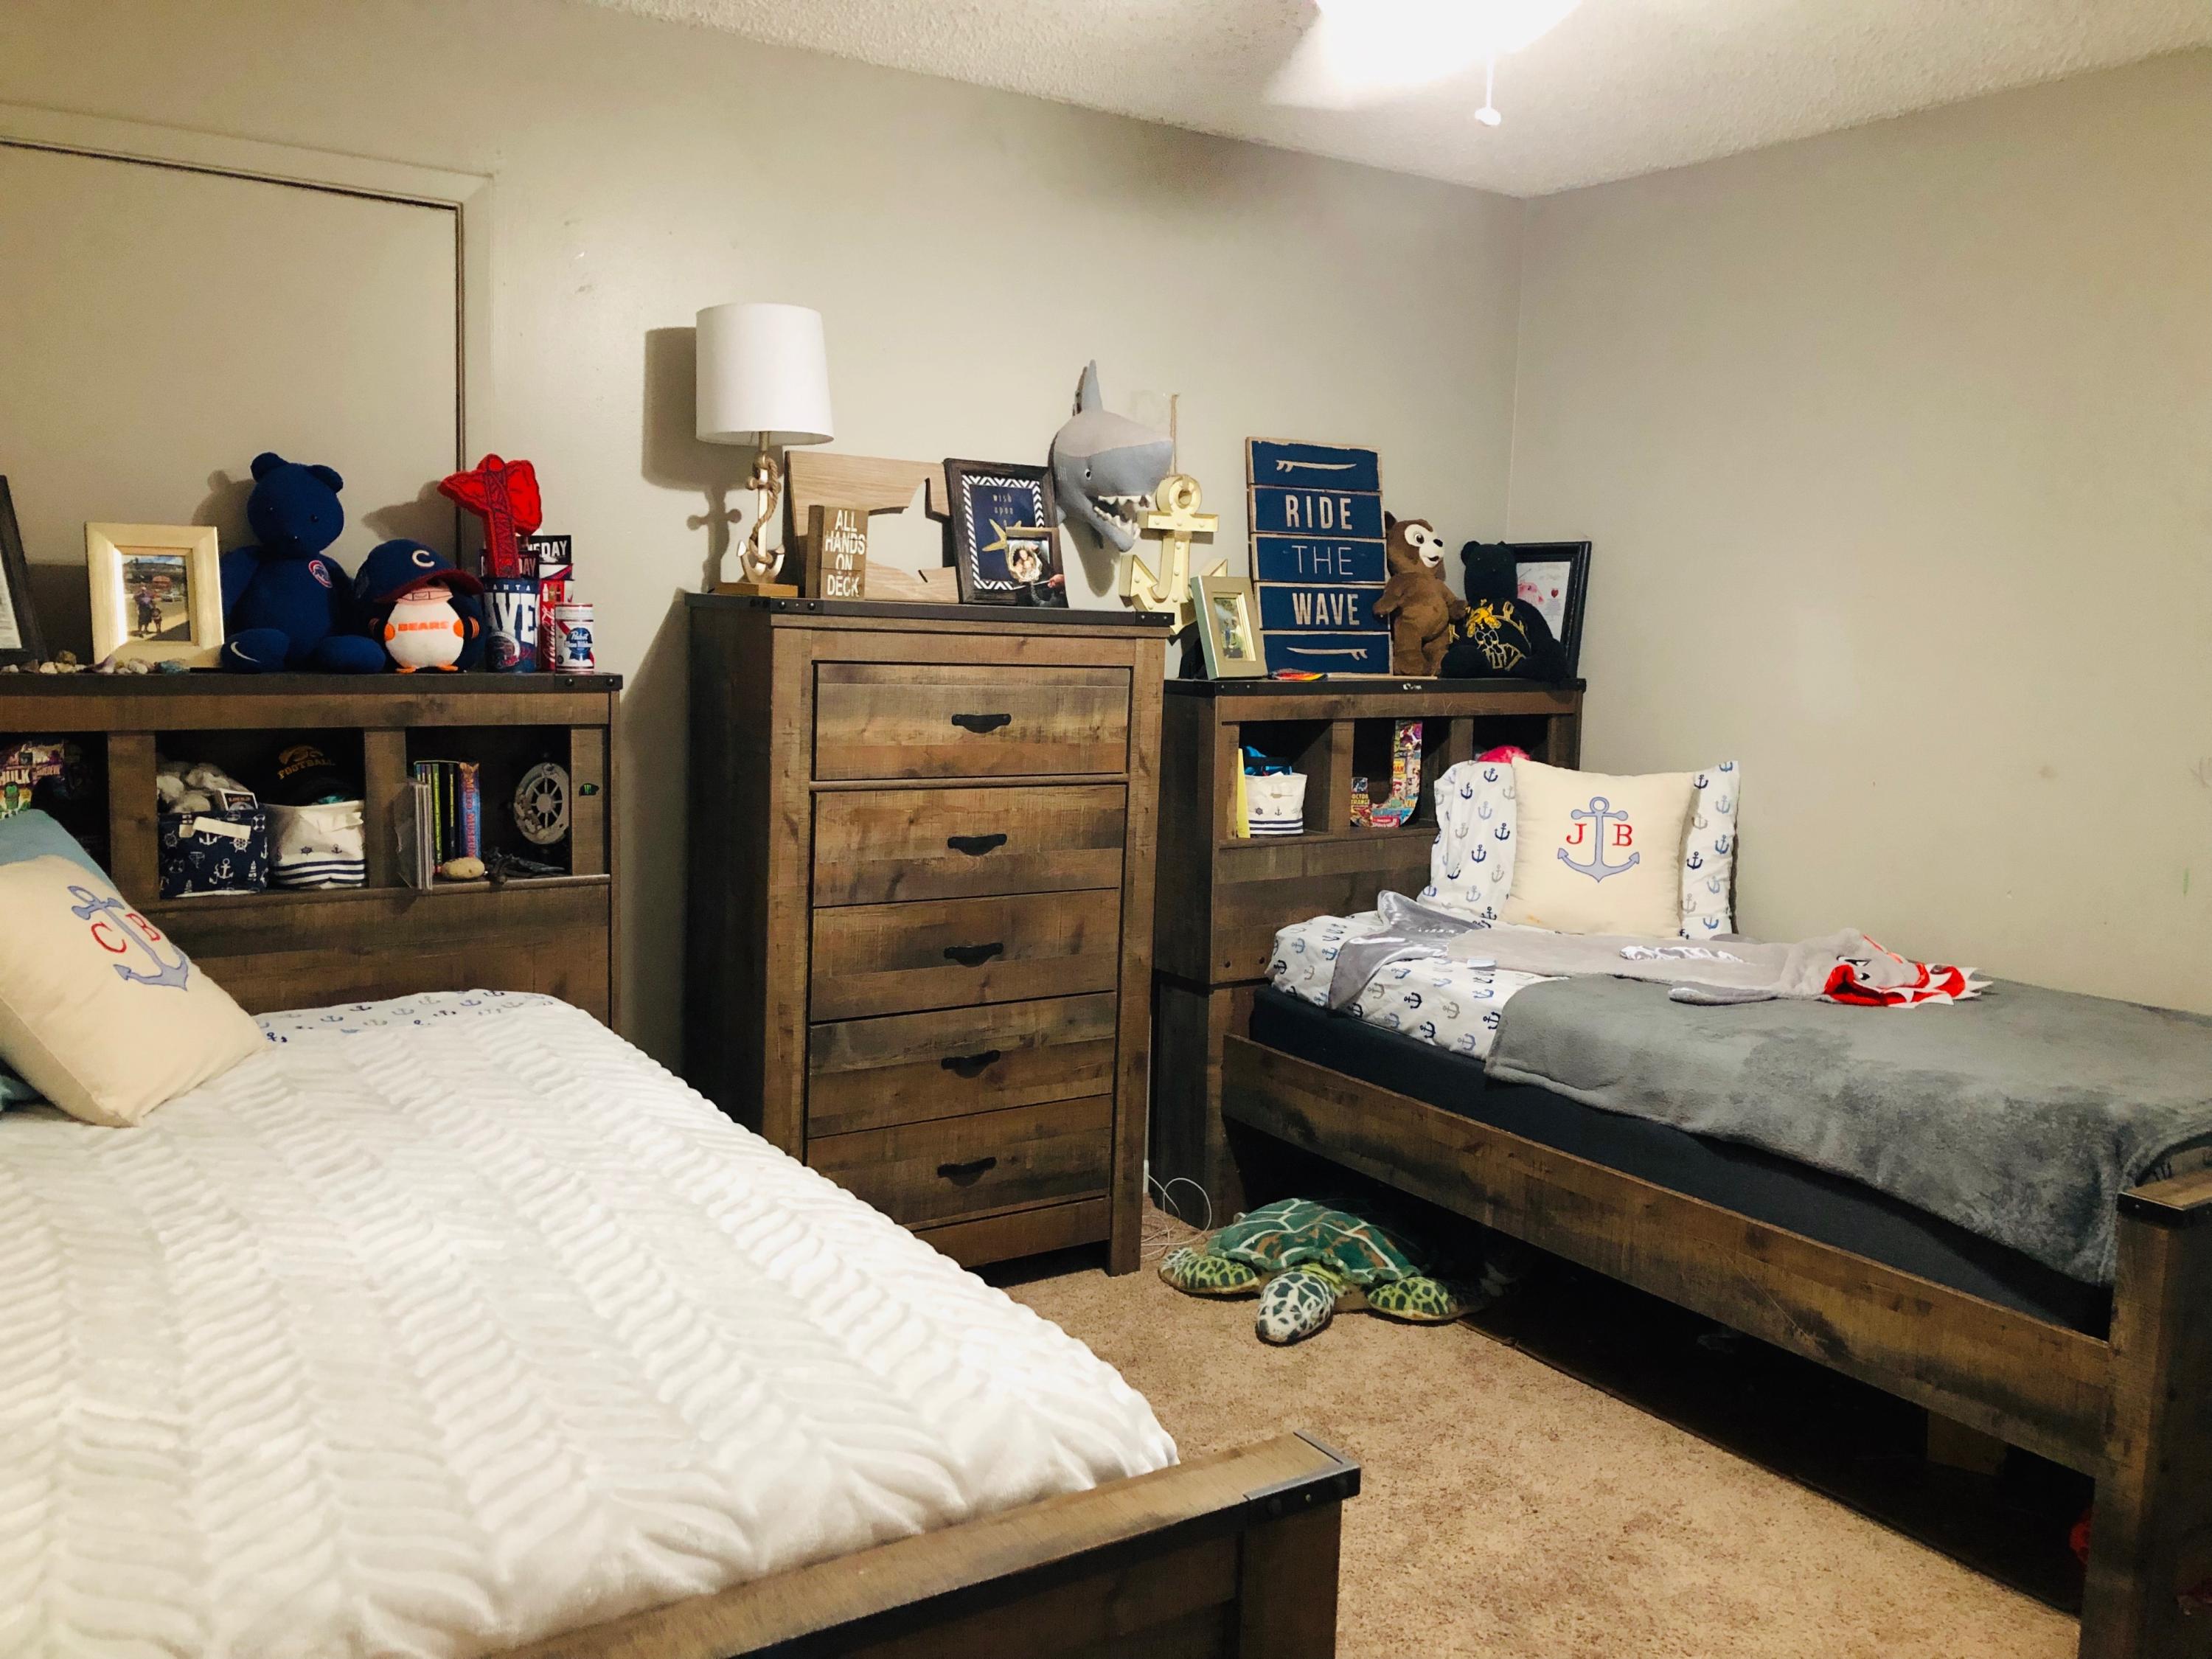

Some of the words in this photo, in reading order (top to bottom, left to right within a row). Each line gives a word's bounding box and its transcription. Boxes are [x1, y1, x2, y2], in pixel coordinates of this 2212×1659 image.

[835, 509, 858, 532] ALL
[1285, 494, 1353, 530] RIDE
[825, 530, 866, 555] HANDS
[835, 553, 853, 571] ON
[1292, 545, 1354, 575] THE
[827, 574, 860, 597] DECK
[1292, 592, 1360, 626] WAVE
[398, 621, 449, 632] BEARS
[277, 758, 335, 780] FOOTBALL
[1566, 823, 1587, 845] J
[1612, 824, 1632, 846] B
[91, 922, 127, 953] C
